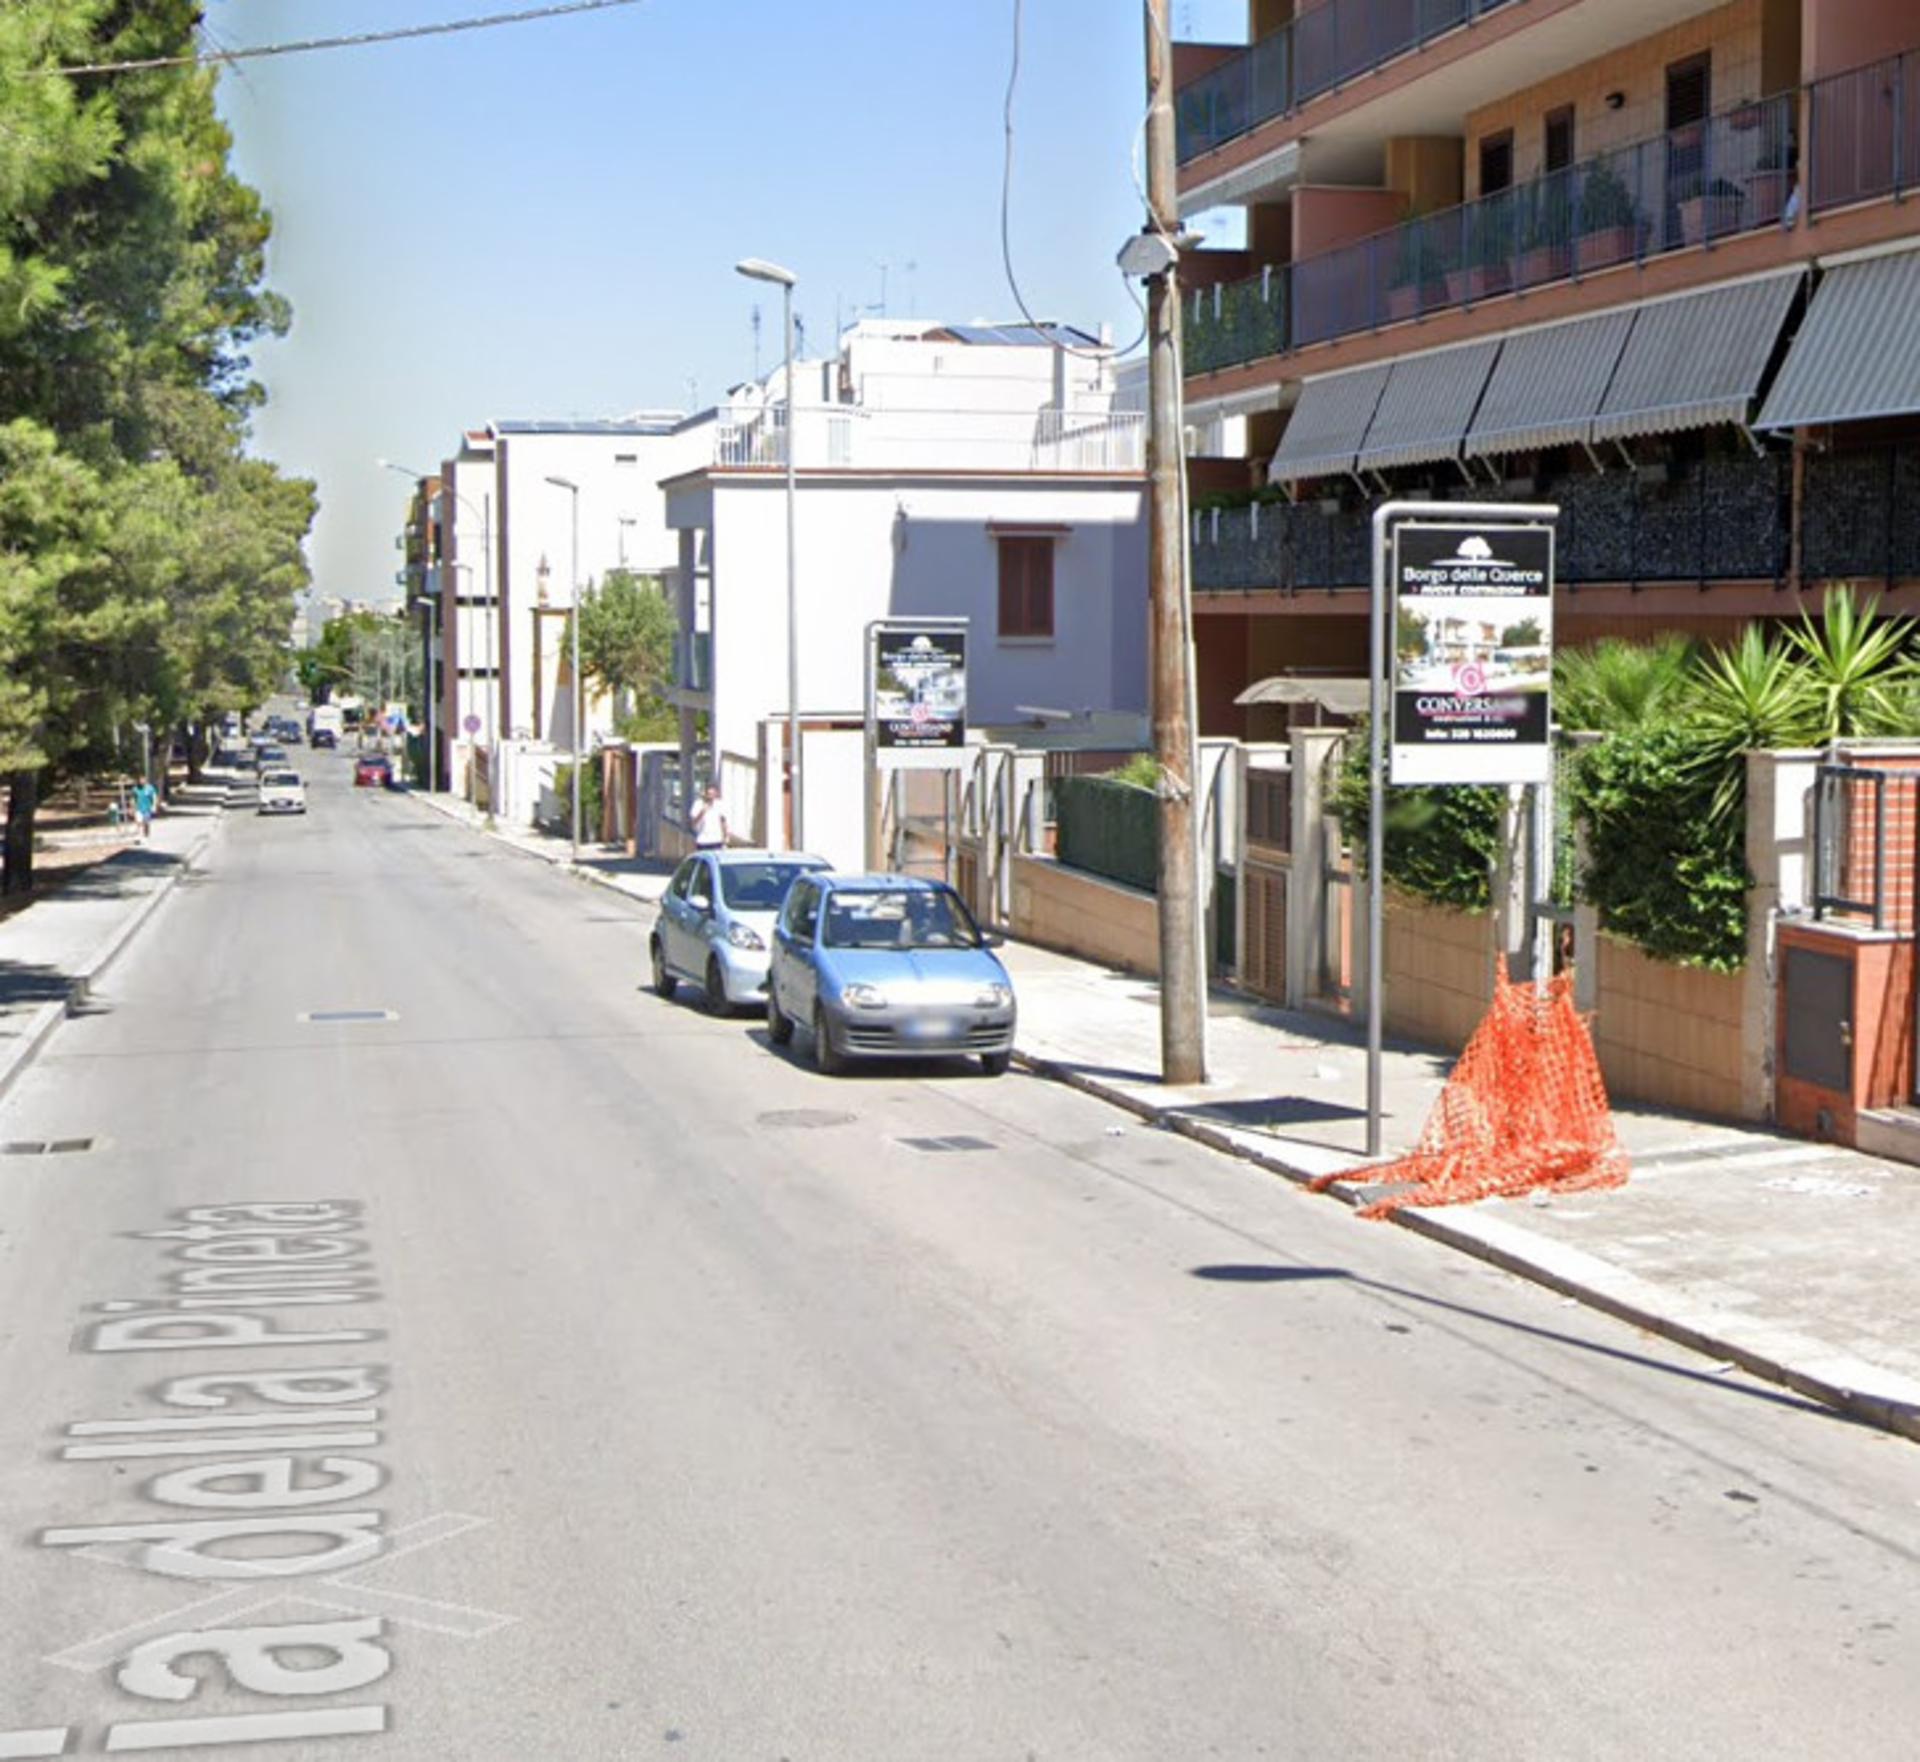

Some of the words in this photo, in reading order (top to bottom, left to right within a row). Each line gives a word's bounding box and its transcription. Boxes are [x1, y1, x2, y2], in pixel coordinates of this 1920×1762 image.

[1403, 567, 1448, 584] Borgo
[1450, 567, 1487, 582] delle
[1489, 567, 1543, 582] Querce
[1416, 697, 1528, 714] CONVERS
